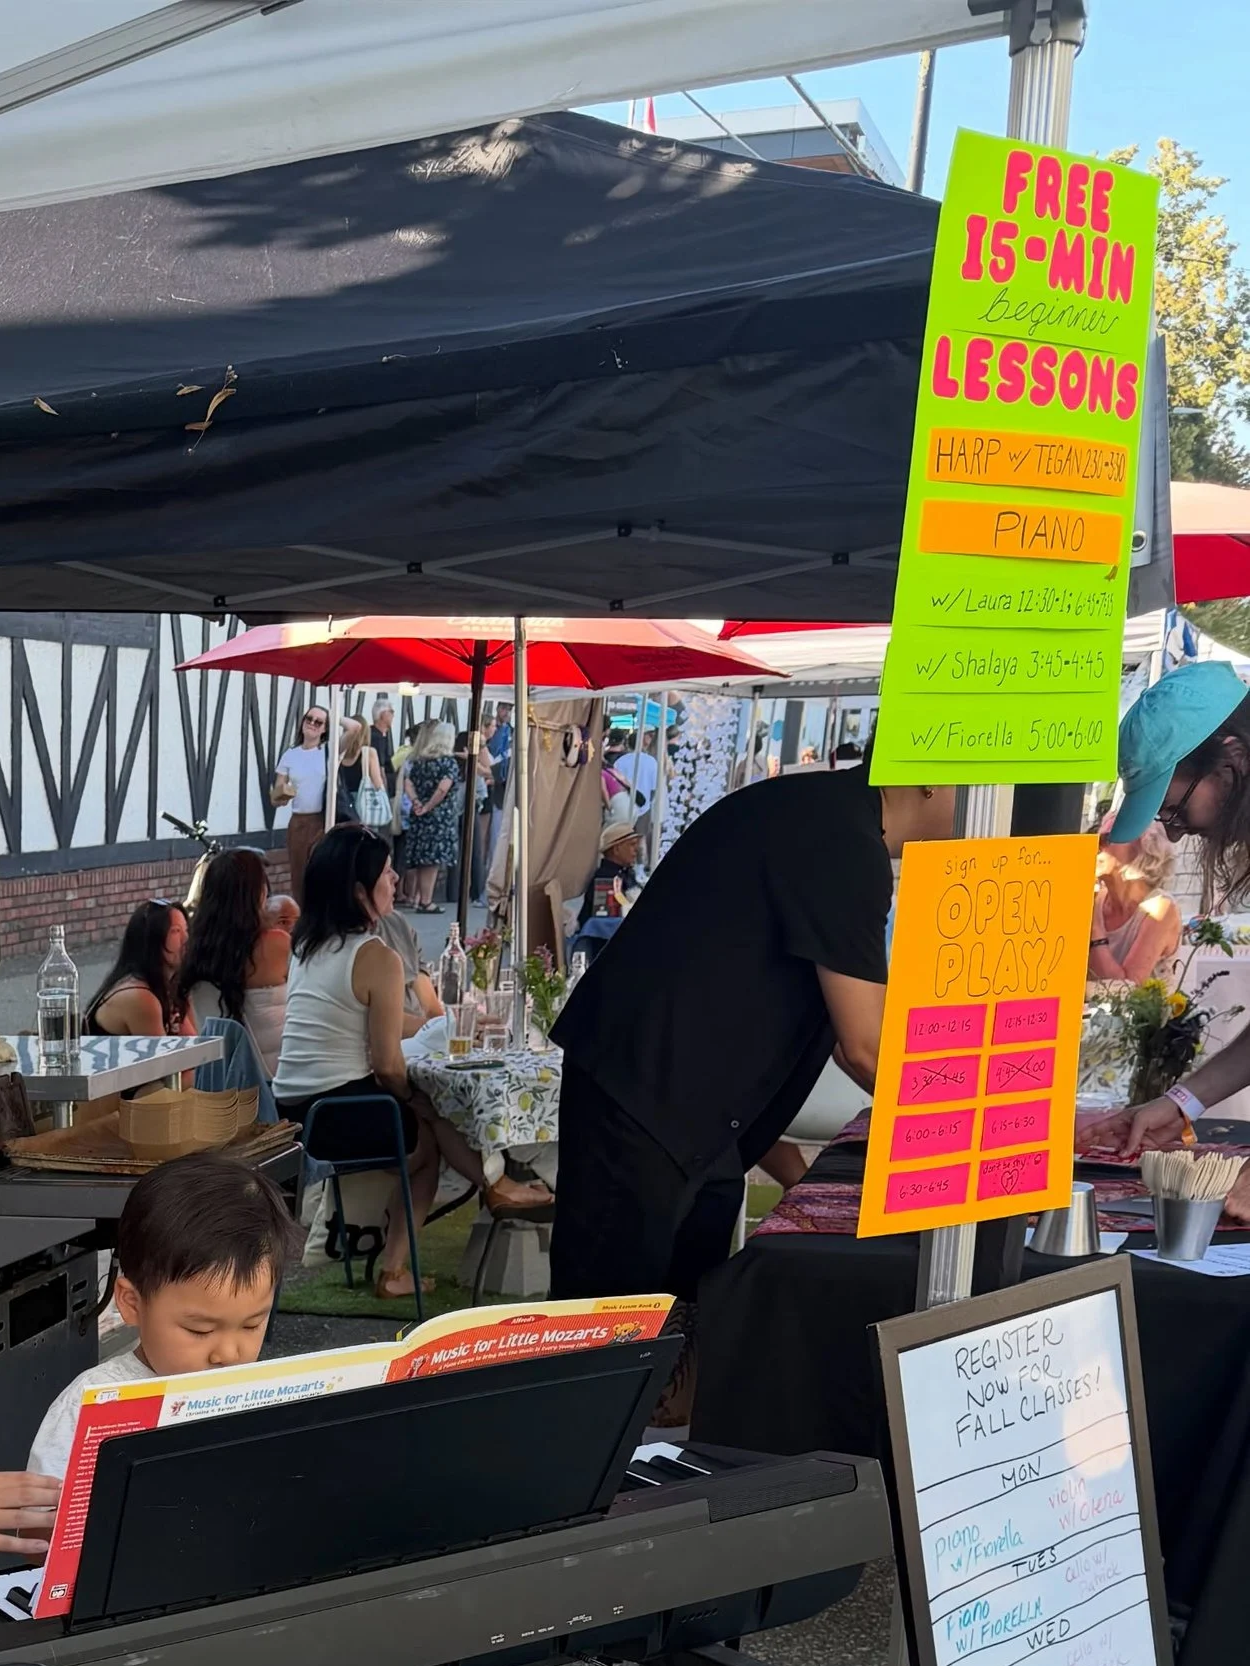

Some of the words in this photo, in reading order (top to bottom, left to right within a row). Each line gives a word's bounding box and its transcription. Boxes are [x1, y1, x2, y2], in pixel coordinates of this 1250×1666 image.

[1002, 150, 1115, 234] FREE
[960, 213, 1136, 305] 15-MIN
[978, 288, 1120, 336] beginner
[931, 335, 1139, 421] LESSONS
[935, 437, 1002, 475] HARP
[1009, 448, 1031, 472] w/
[1034, 444, 1082, 476] TEGAN
[993, 510, 1085, 552] PIANO
[916, 652, 947, 680] w/
[952, 651, 1019, 686] Shalaya
[945, 856, 977, 880] sign
[992, 856, 1008, 874] up
[936, 879, 1051, 940] OPEN
[934, 935, 1065, 999] PLAY!
[430, 1345, 470, 1367] Music
[473, 1338, 494, 1356] for
[497, 1331, 539, 1349] Little
[540, 1325, 609, 1344] Mozarts
[955, 1318, 1064, 1381] REGISTER
[187, 1395, 220, 1411] Music
[224, 1391, 243, 1406] for
[244, 1387, 275, 1402] Little
[277, 1379, 325, 1397] Mozarts
[966, 1380, 1009, 1411] NOW
[1018, 1355, 1062, 1391] FOR
[955, 1409, 1015, 1448] FALL
[1020, 1366, 1101, 1422] CLASSES!
[1001, 1456, 1041, 1489] MON
[1012, 1546, 1058, 1579] TUES
[981, 1596, 1044, 1641] FIORELLA
[1026, 1618, 1071, 1650] WED
